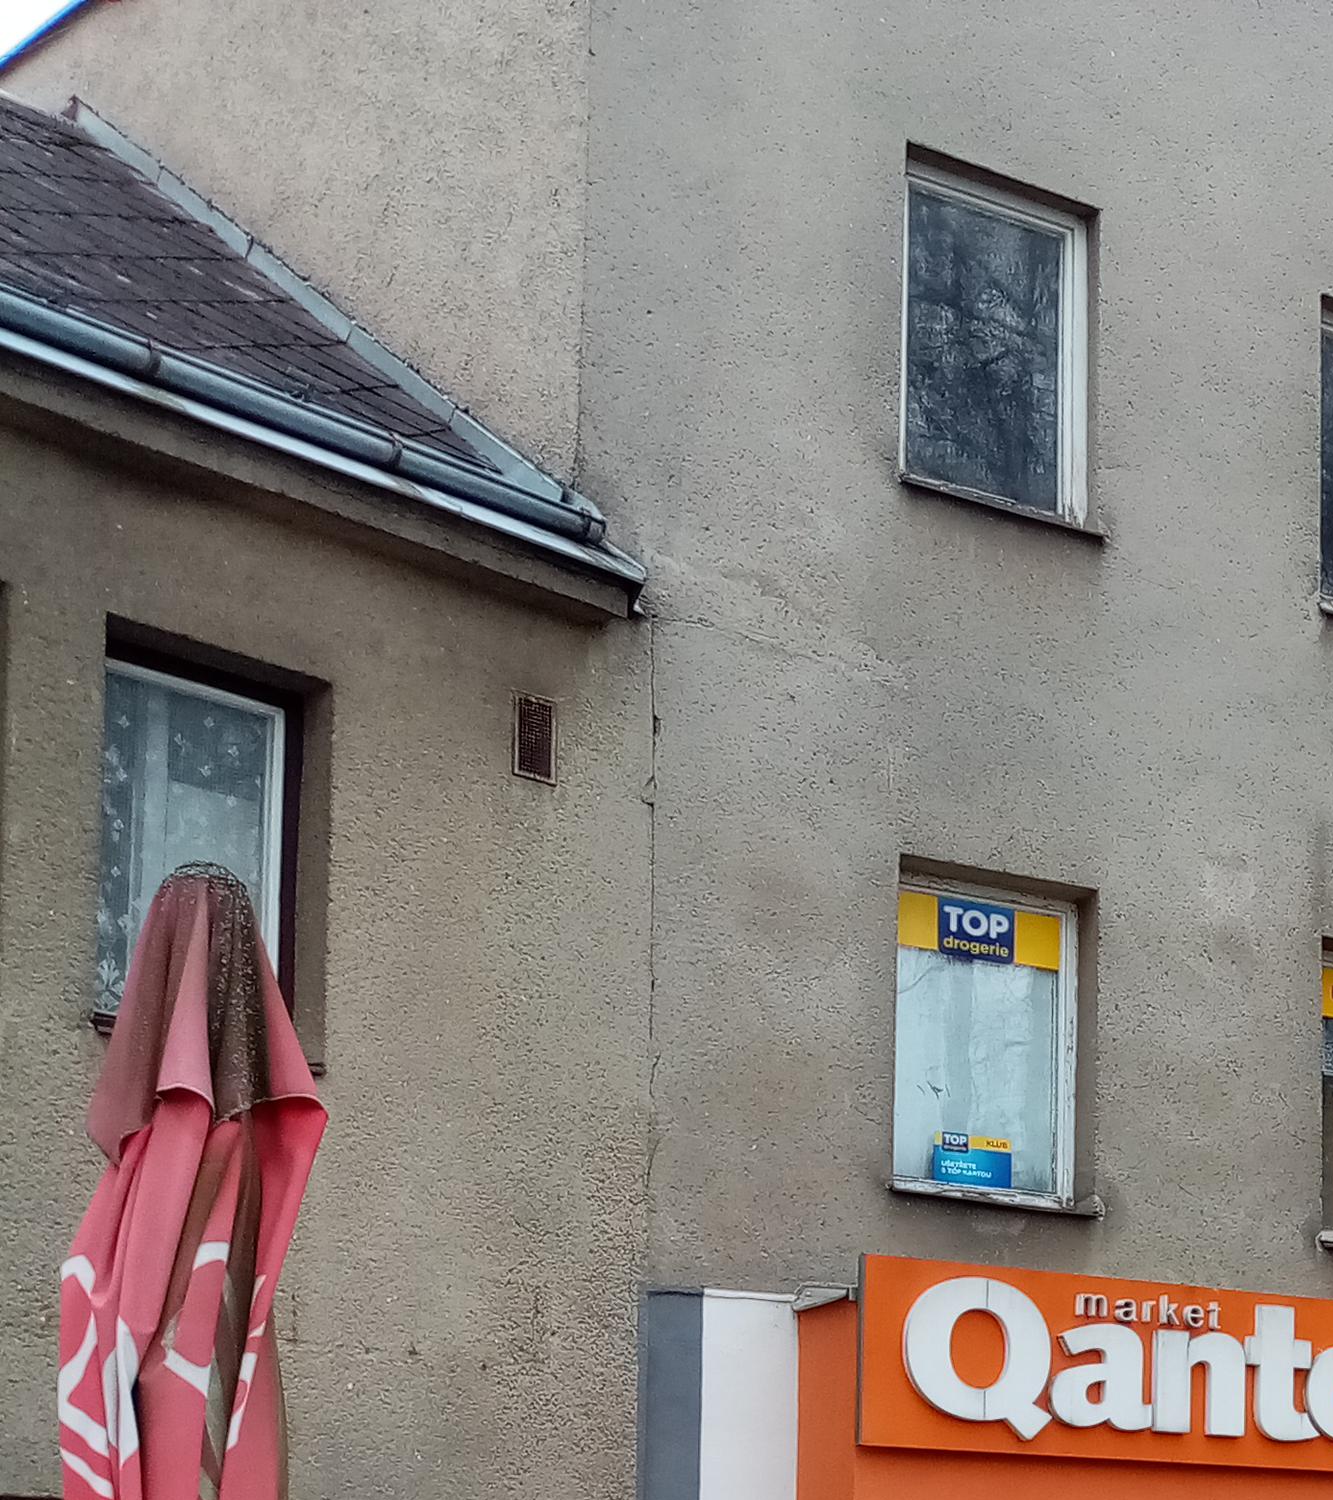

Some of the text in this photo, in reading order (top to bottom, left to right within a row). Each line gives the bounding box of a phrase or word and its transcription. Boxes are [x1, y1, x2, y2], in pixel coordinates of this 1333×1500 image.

[943, 905, 1010, 939] TOP
[943, 936, 1009, 958] drogerie
[943, 1133, 967, 1146] TOP
[1075, 1291, 1221, 1330] market
